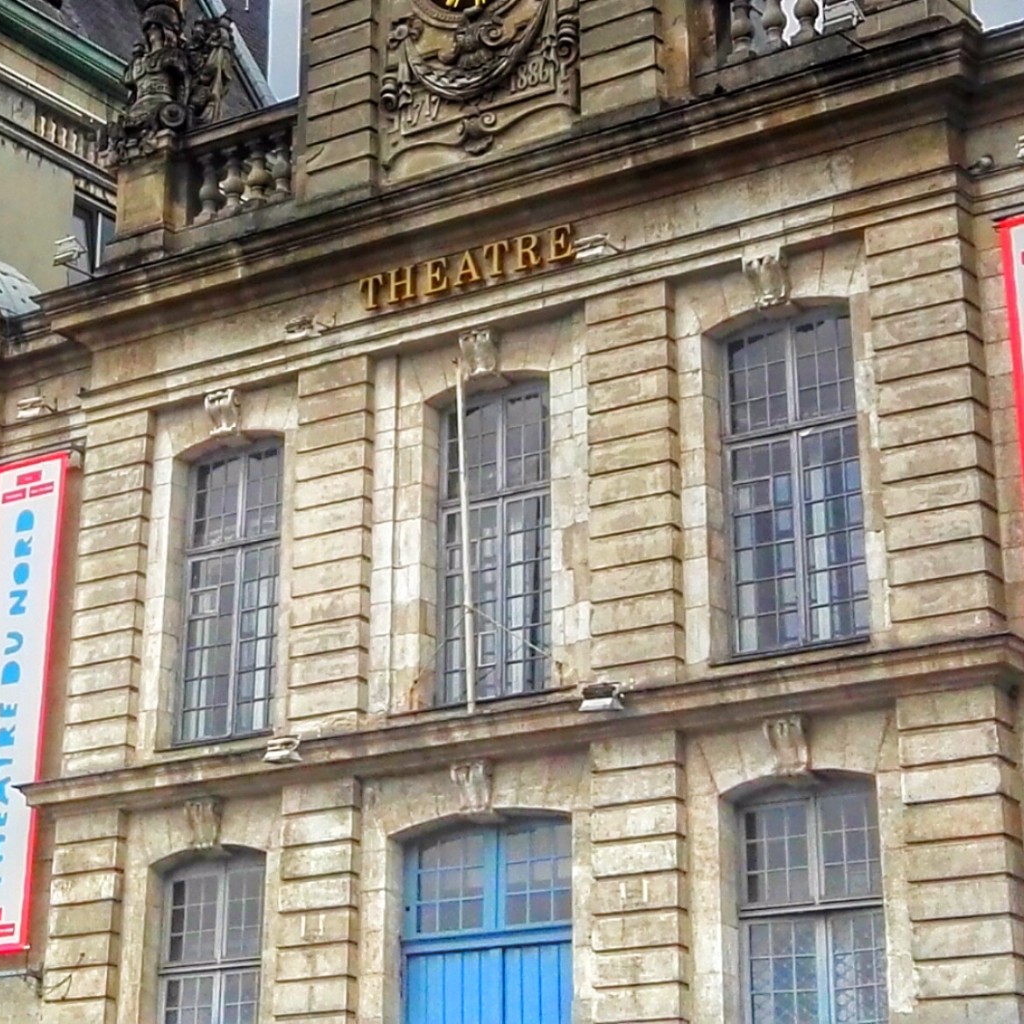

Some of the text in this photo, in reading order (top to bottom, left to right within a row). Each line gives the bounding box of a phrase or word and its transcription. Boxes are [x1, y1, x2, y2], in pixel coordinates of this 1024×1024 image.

[510, 57, 548, 94] 1886
[359, 224, 576, 311] THEATRE
[9, 509, 35, 617] NORD
[1, 632, 23, 686] DU
